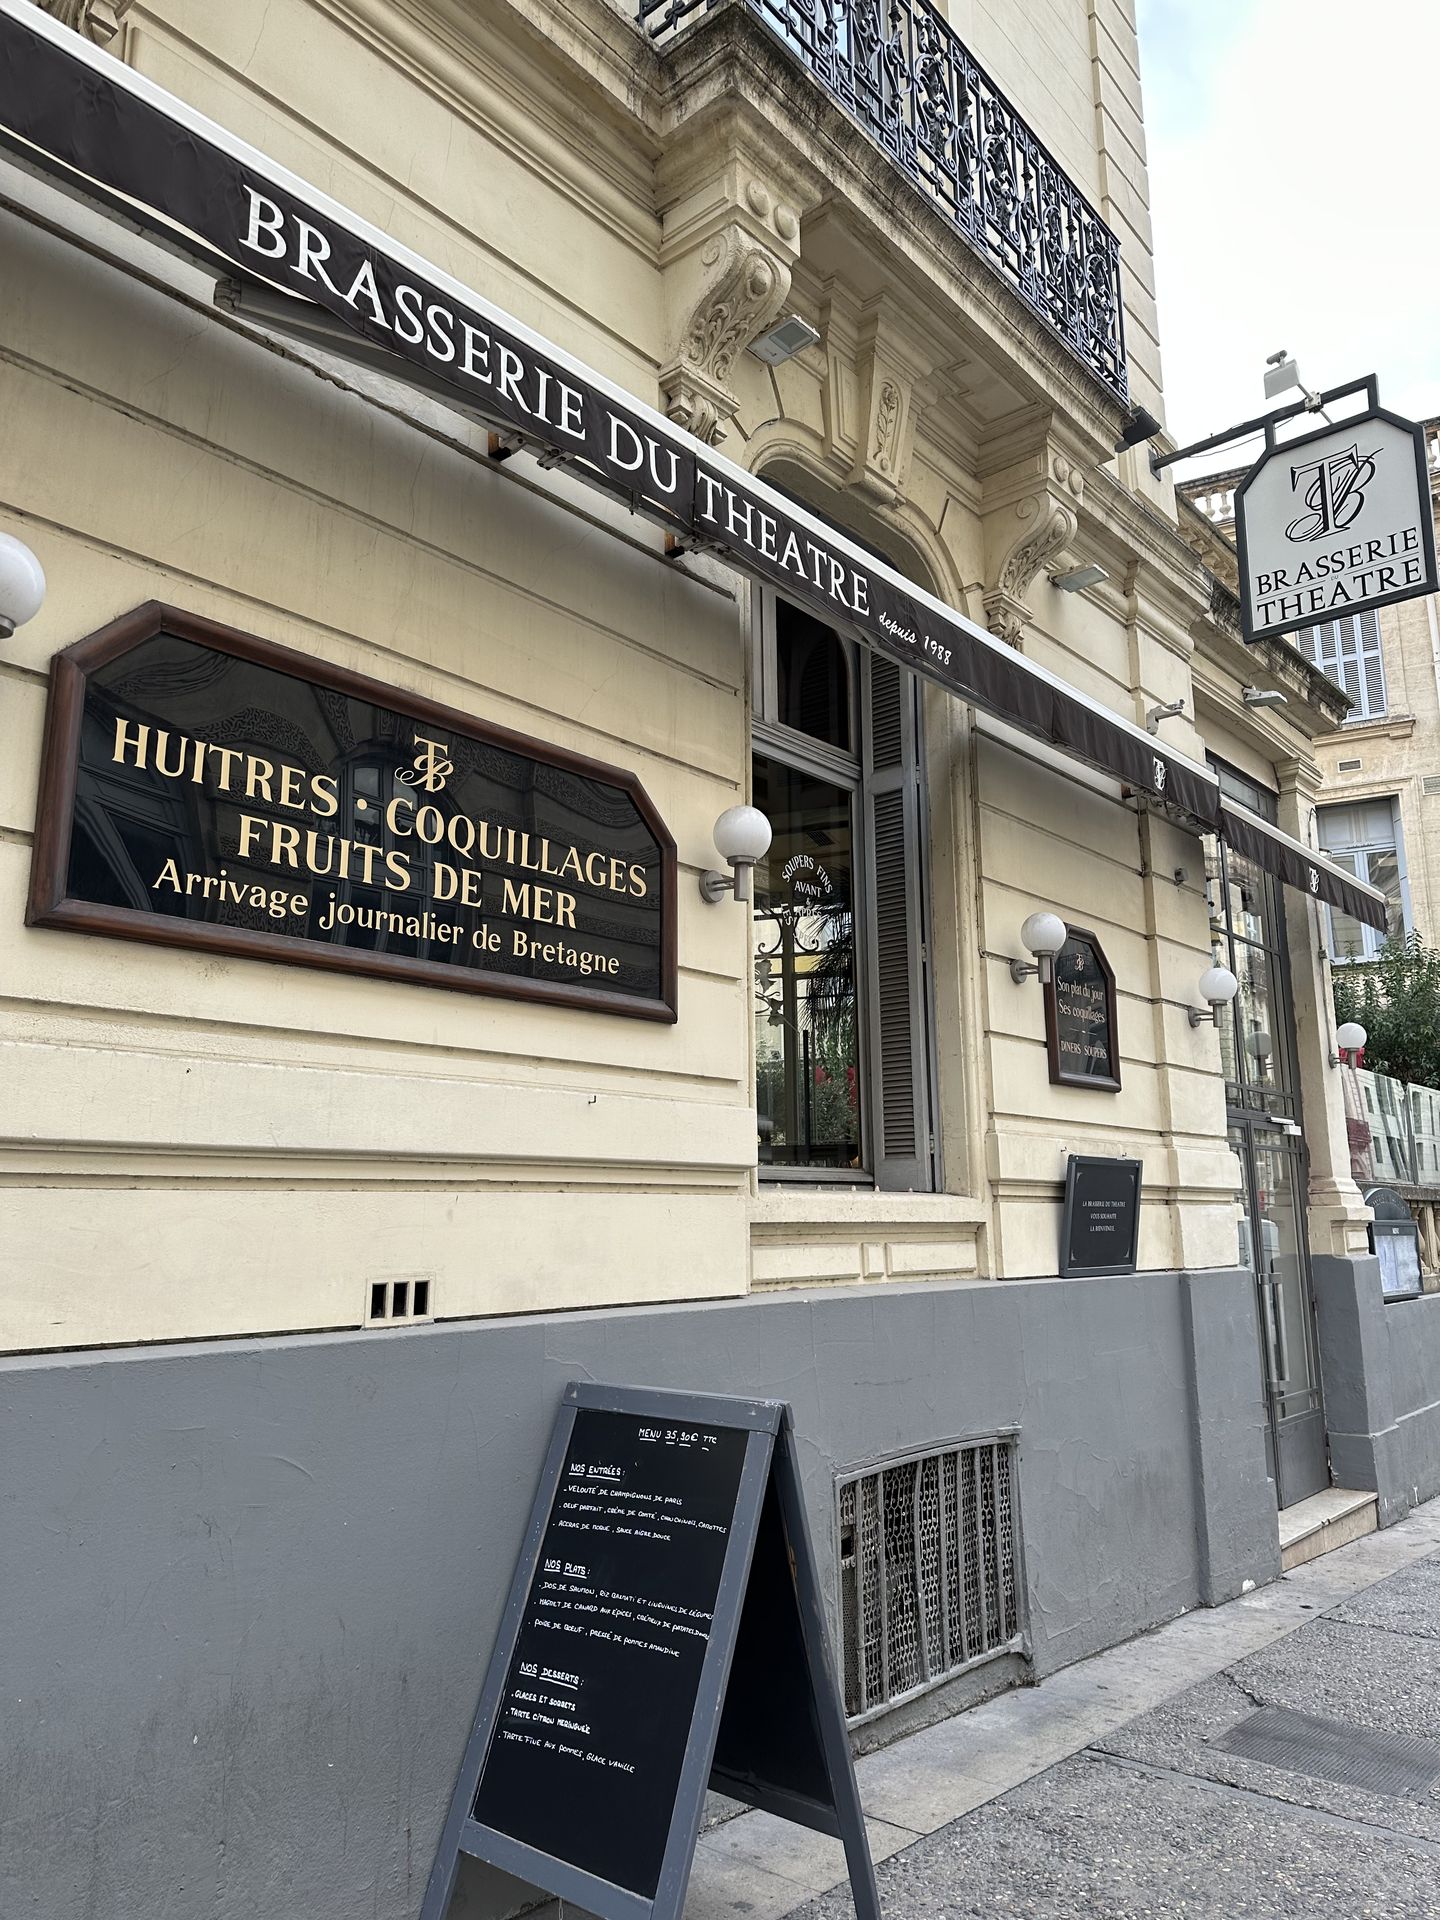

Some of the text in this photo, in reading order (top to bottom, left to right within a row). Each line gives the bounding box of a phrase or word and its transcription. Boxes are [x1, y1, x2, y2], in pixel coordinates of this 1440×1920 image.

[238, 184, 953, 666] BRASSERIE DU THEATRE depuis 1988
[1255, 527, 1419, 597] BRASSERIE
[1256, 557, 1422, 627] THEATRE
[111, 717, 649, 898] HUITRES COQUILLAGES
[237, 813, 578, 930] FRUITS DE MER
[781, 854, 833, 894] SOUPERS FINS
[794, 880, 822, 898] AVANT
[152, 858, 620, 976] Arrivage journalier de Bretagne
[1057, 976, 1104, 1004] Son plat du jour
[1058, 1000, 1105, 1024] Ses coquillages
[1060, 1040, 1107, 1059] DINERS SOUPERS
[638, 1428, 661, 1440] MENU
[703, 1435, 717, 1444] TTC
[570, 1463, 586, 1473] NOS
[610, 1490, 652, 1500] CHAMPIGNONS
[664, 1497, 682, 1505] PARIS
[558, 1520, 580, 1528] ACCRAS
[615, 1526, 632, 1534] SAUCE
[634, 1529, 652, 1537] AIGRE
[651, 1532, 671, 1541] DOUCE
[698, 1521, 727, 1534] CAROTTES
[544, 1558, 561, 1570] NOS
[541, 1581, 557, 1590] DOS
[678, 1606, 688, 1615] DE
[539, 1598, 561, 1608] MAGRET
[561, 1601, 572, 1609] DE
[574, 1603, 598, 1612] CANARD
[662, 1620, 672, 1628] DE
[612, 1634, 622, 1642] DE
[623, 1637, 648, 1648] POMMES
[648, 1643, 680, 1657] AMANDINE
[520, 1662, 538, 1674] NOS
[515, 1689, 576, 1711] GLACES ET SORBETS
[510, 1707, 531, 1720] TARTE
[532, 1712, 555, 1724] CITRON
[502, 1730, 523, 1742] TARTE
[523, 1735, 542, 1746] FINE
[544, 1741, 556, 1750] AUX
[586, 1752, 606, 1765] GLACE
[608, 1759, 635, 1774] VANILLE
